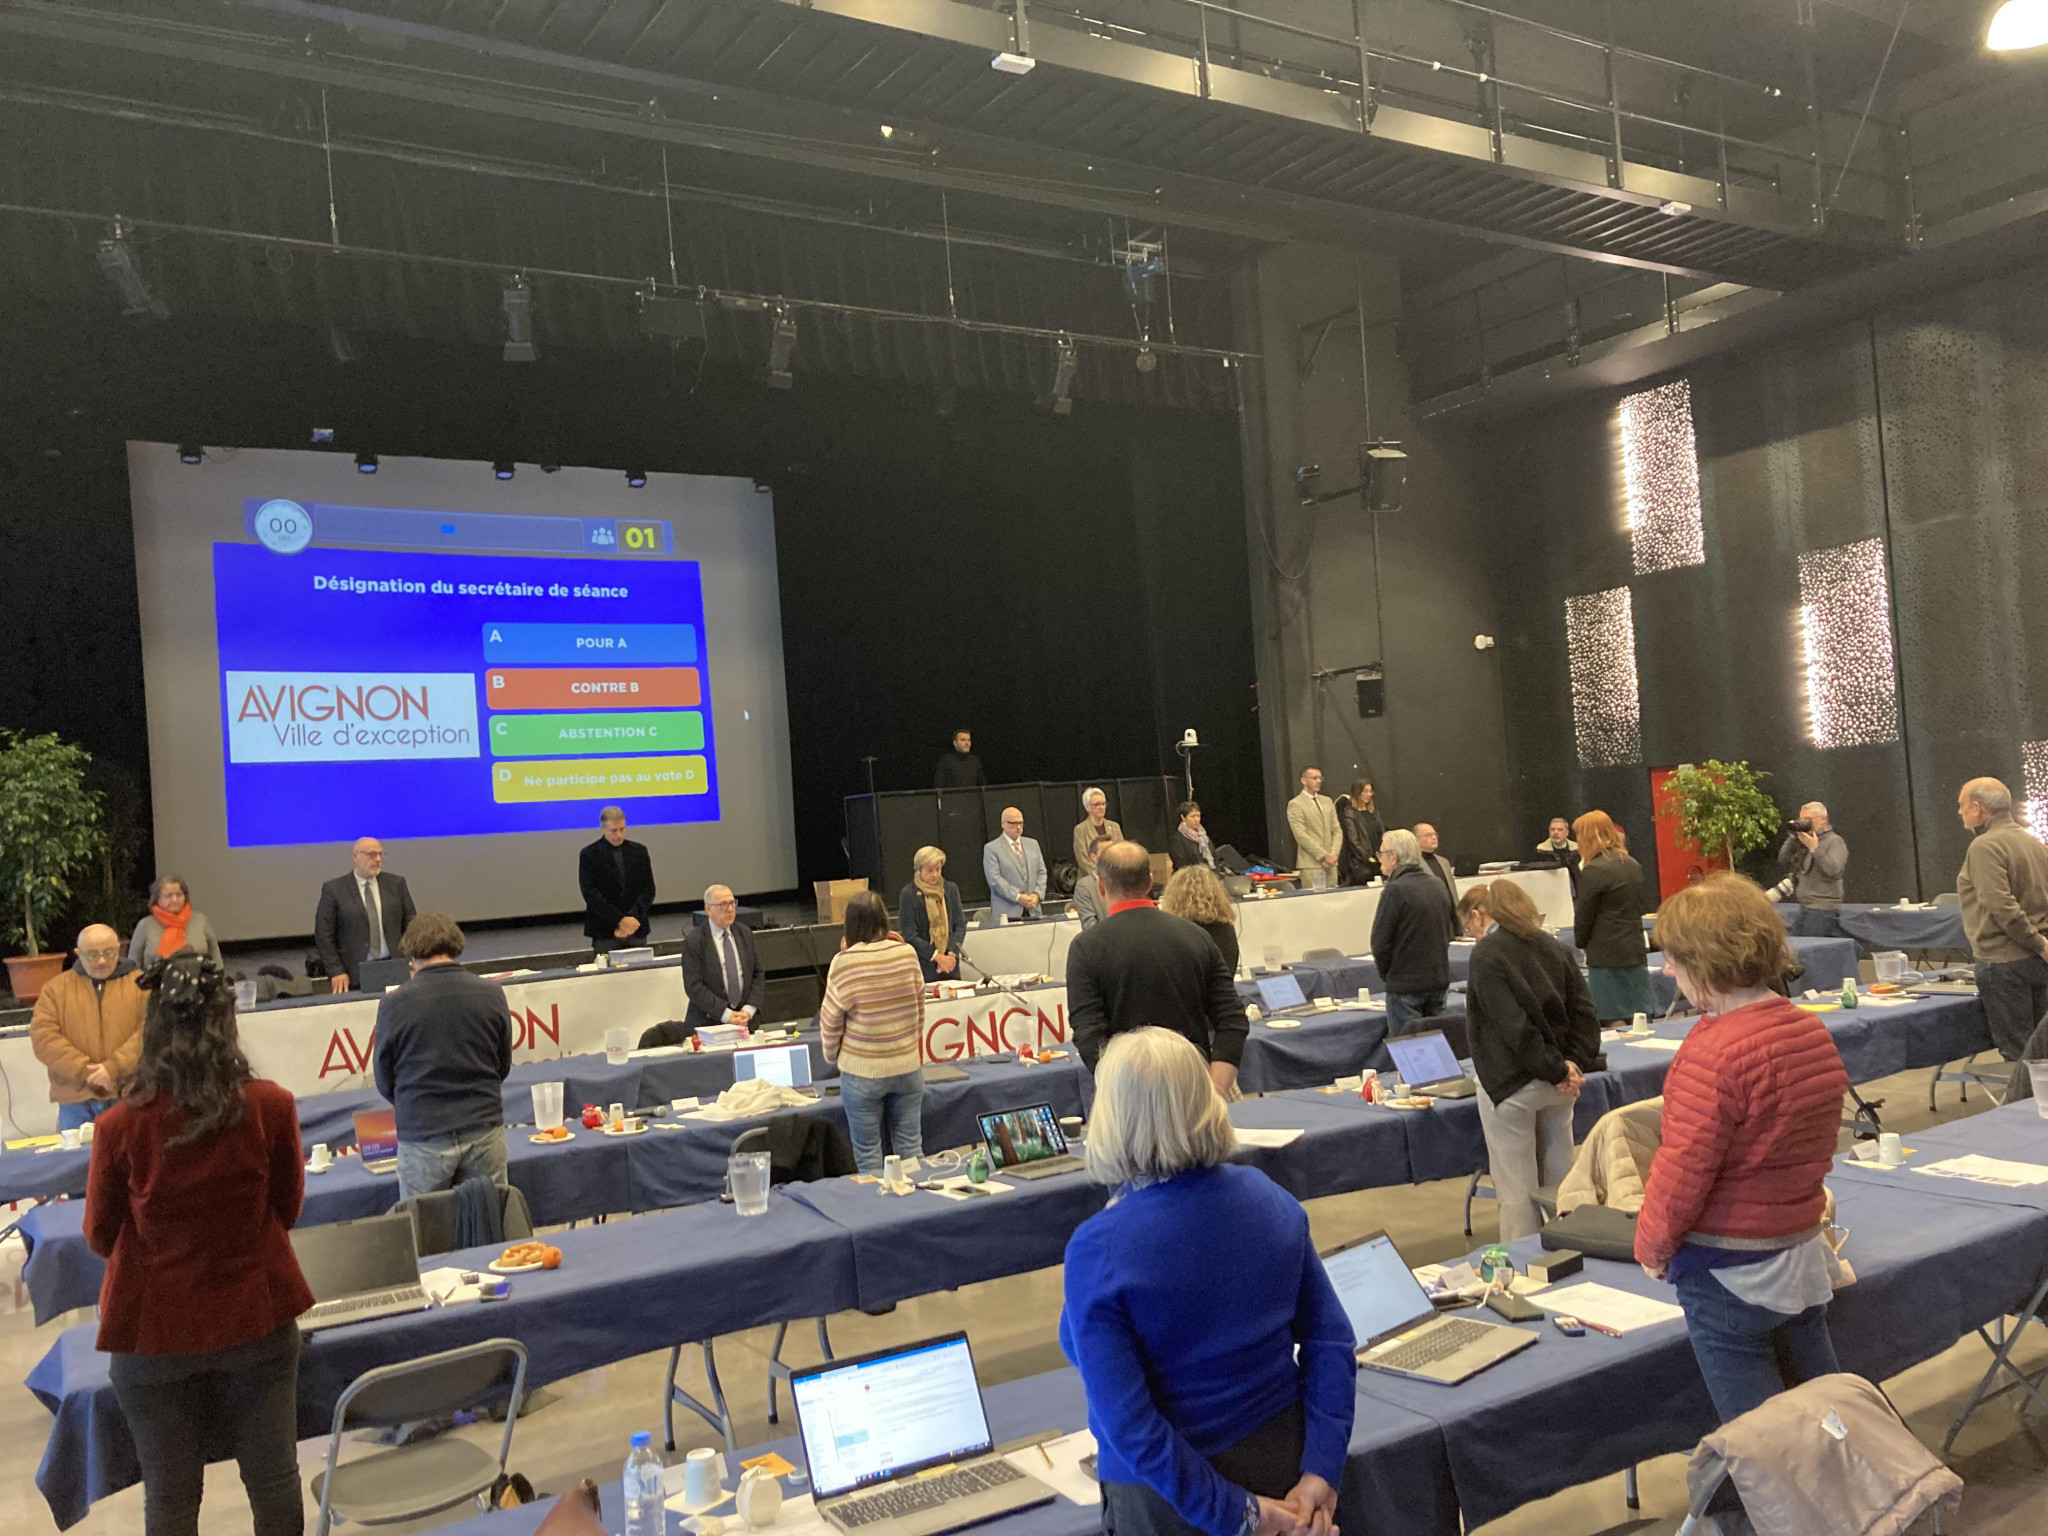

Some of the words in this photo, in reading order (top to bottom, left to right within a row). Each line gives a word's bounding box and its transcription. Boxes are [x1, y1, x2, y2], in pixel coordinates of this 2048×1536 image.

[269, 517, 297, 534] 00
[626, 526, 655, 549] 01
[313, 575, 426, 594] Désignation
[431, 580, 453, 594] du
[458, 581, 544, 597] secrétaire
[548, 583, 569, 597] de
[573, 584, 629, 598] séance
[489, 629, 503, 643] A
[576, 637, 614, 648] POUR
[617, 638, 628, 648] A
[492, 675, 505, 689] B
[571, 682, 627, 693] CONTRE
[630, 682, 640, 693] B
[237, 685, 430, 722] AVIGNON
[272, 723, 323, 746] Ville
[333, 722, 471, 749] d'exception
[496, 722, 508, 736] C
[558, 726, 646, 740] ABSTENTION
[649, 726, 658, 737] C
[499, 769, 512, 782] D
[524, 776, 543, 787] Ne
[547, 772, 606, 787] participe
[610, 774, 633, 785] pas
[636, 773, 651, 782] au
[654, 770, 682, 781] vote
[686, 770, 695, 780] D
